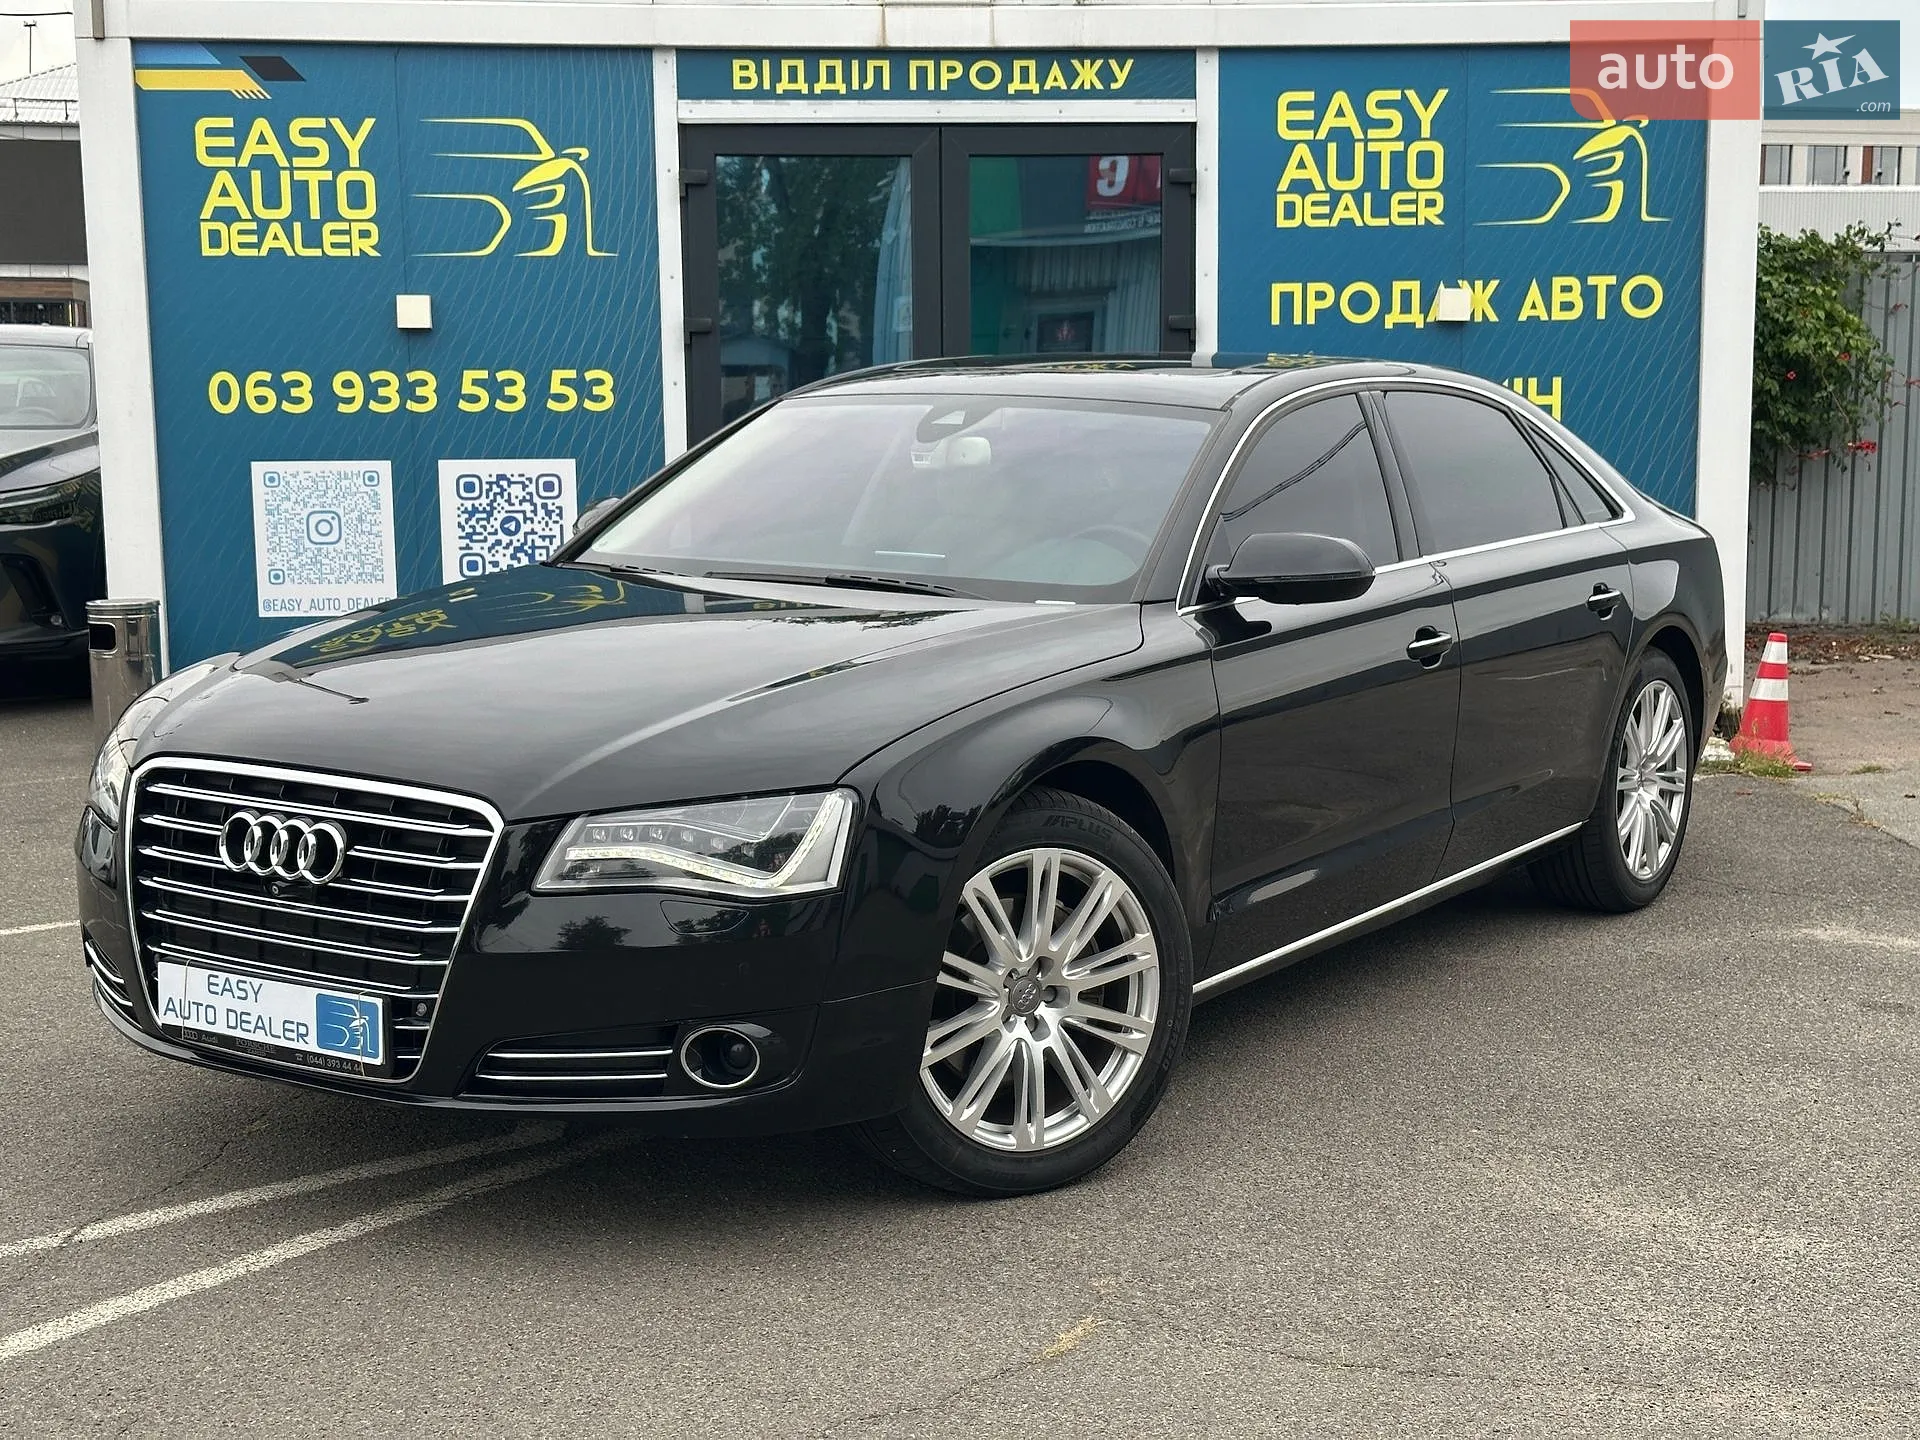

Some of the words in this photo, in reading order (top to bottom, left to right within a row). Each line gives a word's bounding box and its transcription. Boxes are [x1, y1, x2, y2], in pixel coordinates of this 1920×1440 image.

[732, 58, 891, 95] ВІДДІЛ
[908, 57, 1135, 95] ПРОДАЖУ
[1276, 88, 1448, 140] EASY
[194, 117, 376, 168] EASY
[1278, 141, 1446, 191] AUTO
[200, 170, 377, 220] AUTO
[1276, 192, 1445, 228] DEALER
[199, 221, 381, 257] DEALER
[1518, 274, 1664, 321] АВТО
[208, 370, 314, 415] 063
[332, 369, 438, 414] 933
[458, 369, 528, 413] 53
[547, 368, 616, 413] 53
[207, 973, 263, 1004] EASY
[163, 996, 217, 1026] AUTO
[226, 1007, 310, 1045] DEALER
